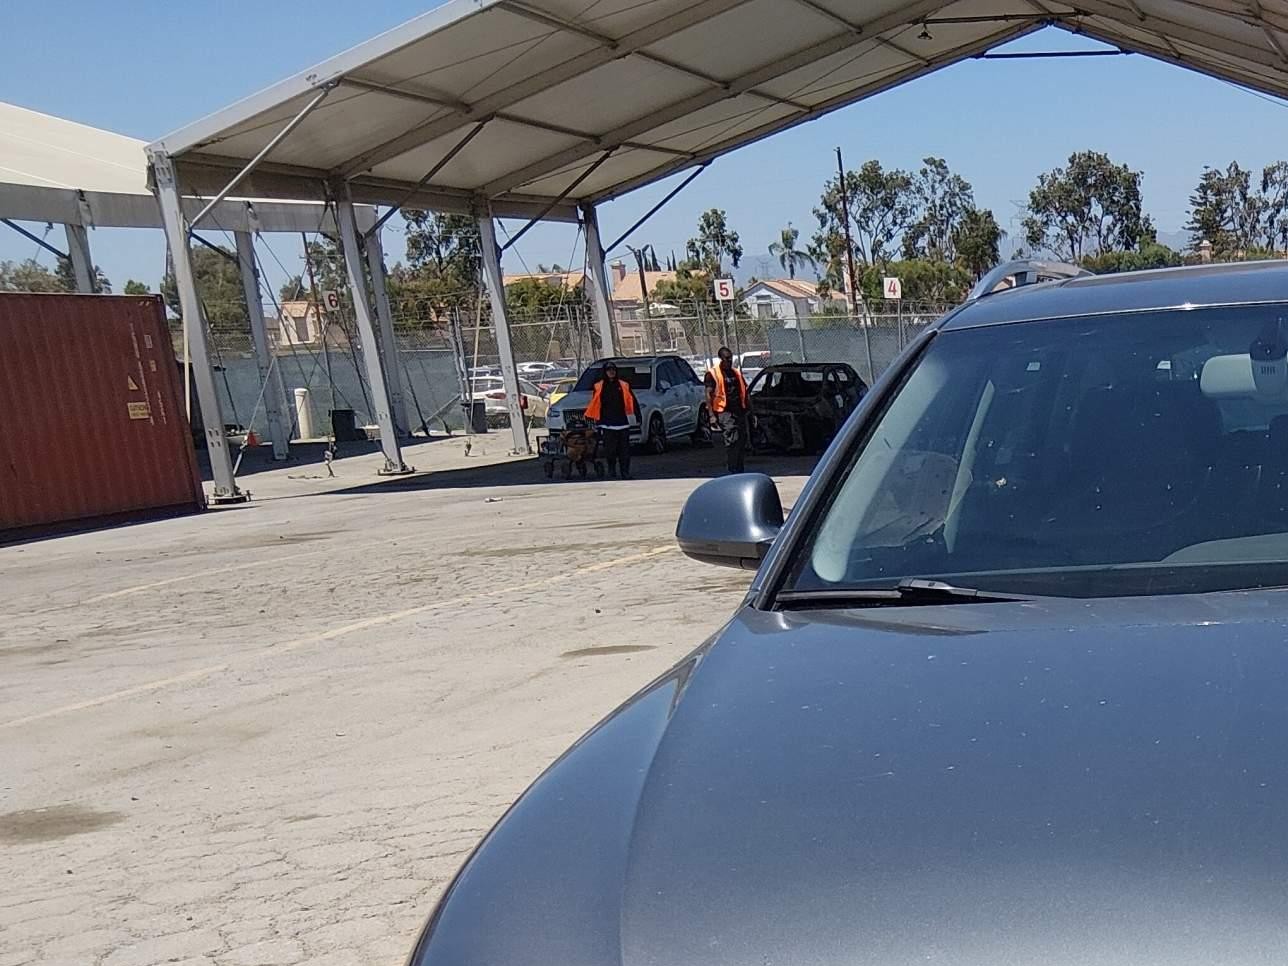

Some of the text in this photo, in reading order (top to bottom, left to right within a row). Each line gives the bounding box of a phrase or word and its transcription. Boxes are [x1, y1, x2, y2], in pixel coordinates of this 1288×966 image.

[719, 281, 730, 297] 5
[888, 280, 897, 296] 4
[328, 293, 338, 308] 6
